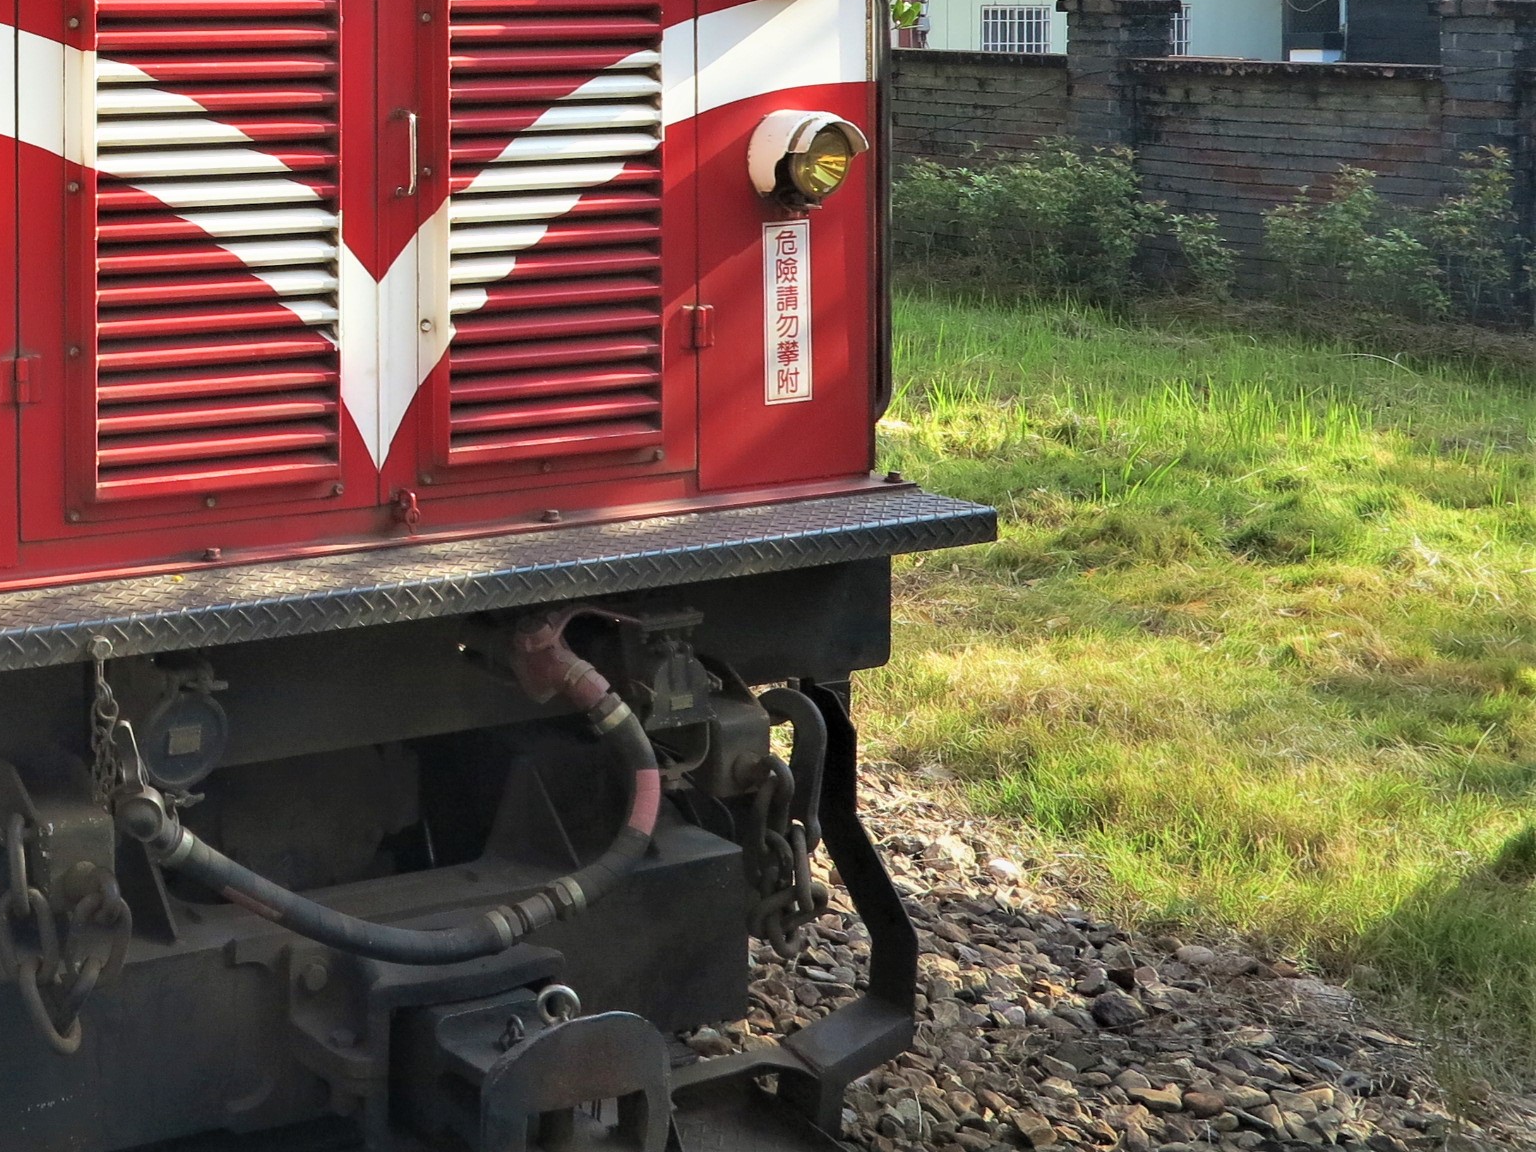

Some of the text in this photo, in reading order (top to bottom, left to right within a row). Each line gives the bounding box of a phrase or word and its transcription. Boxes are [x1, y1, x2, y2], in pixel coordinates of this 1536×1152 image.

[774, 229, 801, 396] 危險請勿攀附
